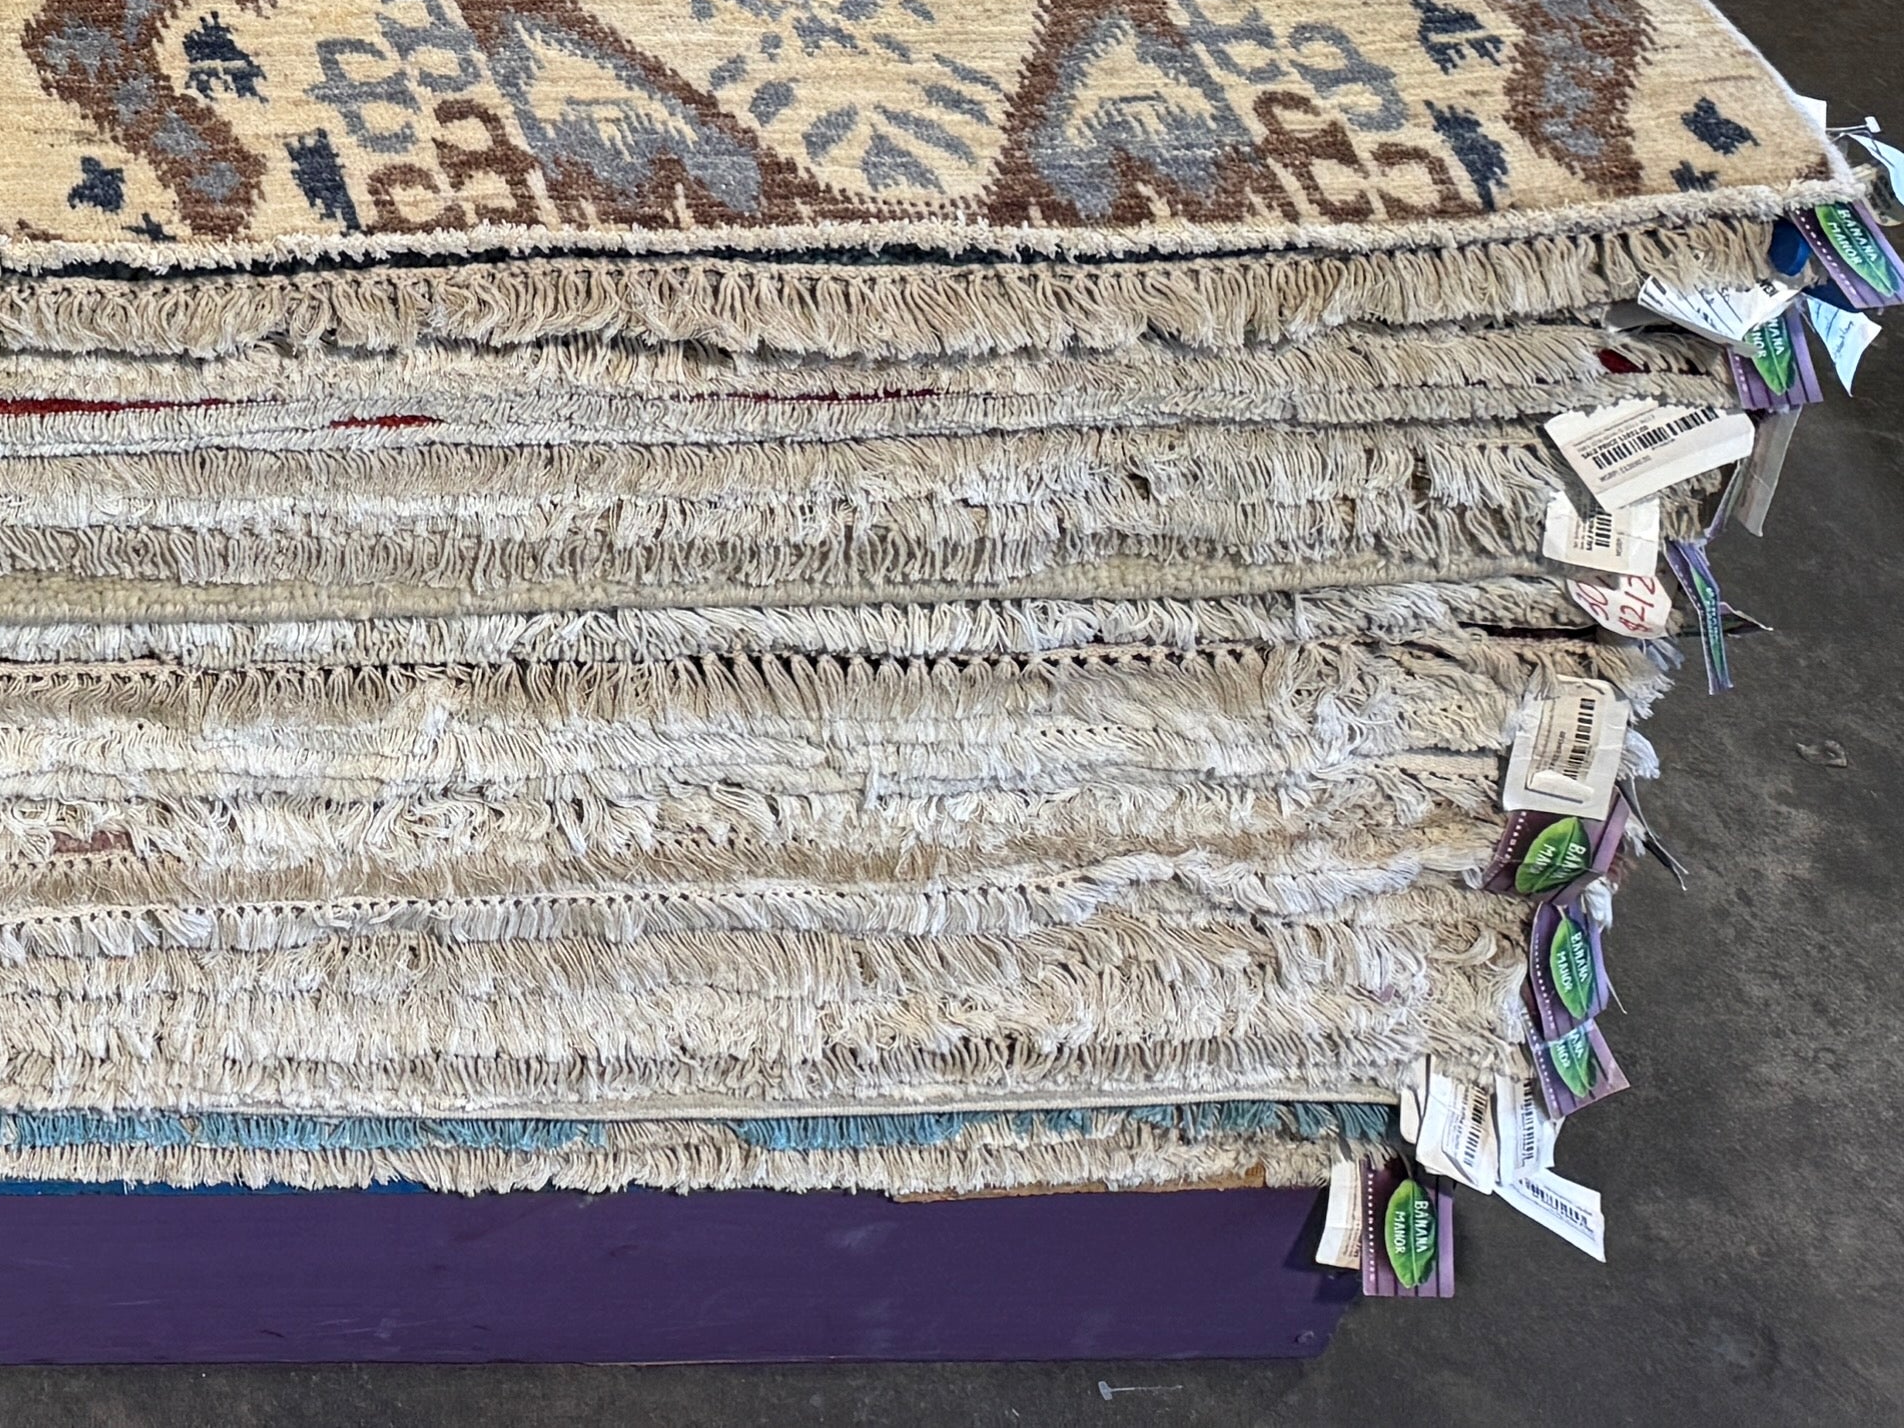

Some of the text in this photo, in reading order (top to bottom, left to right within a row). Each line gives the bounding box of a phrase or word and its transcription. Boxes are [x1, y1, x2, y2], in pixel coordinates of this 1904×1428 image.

[1828, 221, 1863, 265] MANOR
[1837, 209, 1879, 262] BANANA
[1751, 331, 1767, 359] NOR
[1768, 317, 1785, 355] NANA
[1556, 952, 1573, 992] MANOR
[1570, 931, 1586, 982] BANANA
[1394, 1211, 1407, 1254] MANOR
[1414, 1200, 1429, 1253] BANANA
